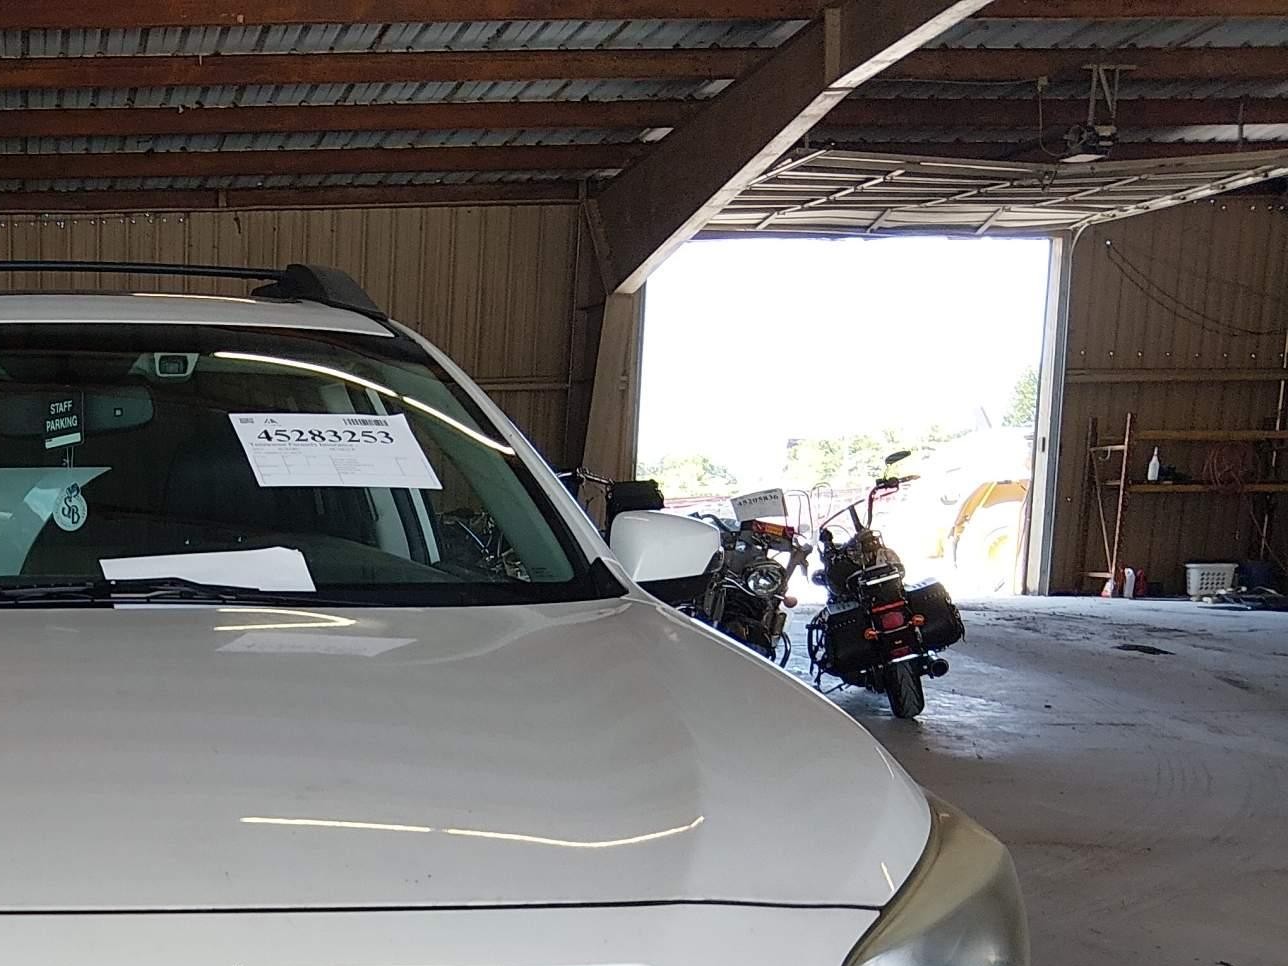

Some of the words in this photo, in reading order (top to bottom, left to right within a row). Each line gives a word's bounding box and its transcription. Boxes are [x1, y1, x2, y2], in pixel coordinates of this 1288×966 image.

[50, 400, 73, 415] STAFF
[46, 415, 78, 433] PARKING
[257, 428, 395, 444] 45283253
